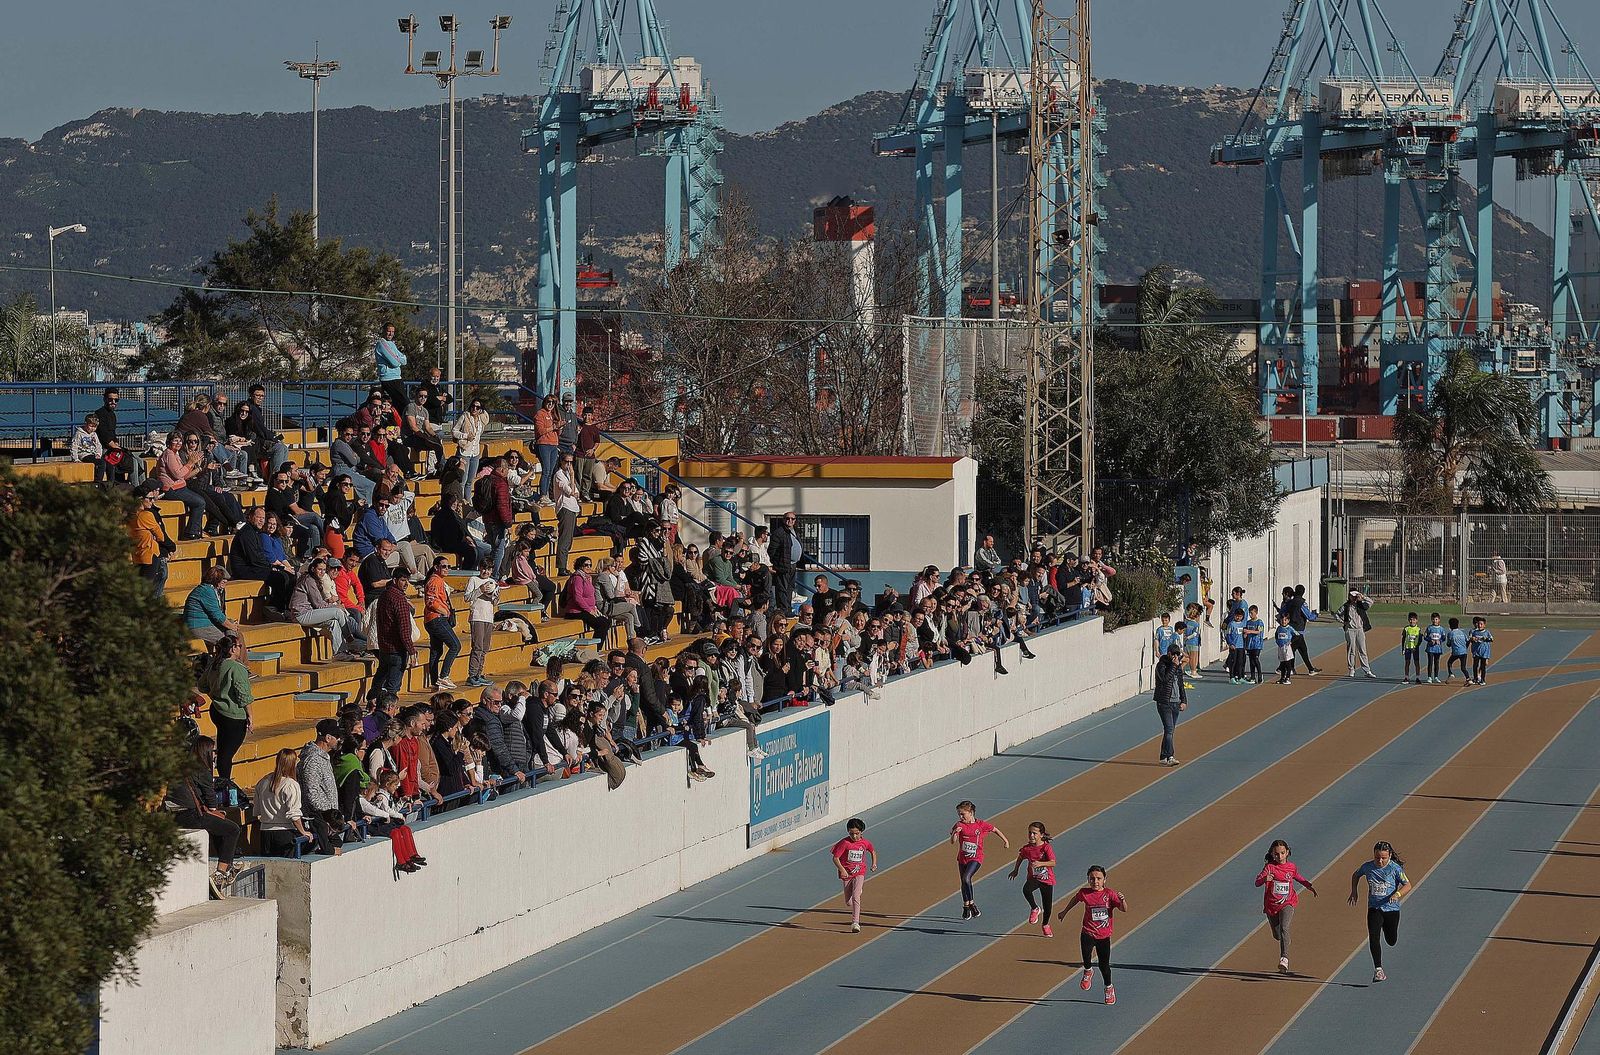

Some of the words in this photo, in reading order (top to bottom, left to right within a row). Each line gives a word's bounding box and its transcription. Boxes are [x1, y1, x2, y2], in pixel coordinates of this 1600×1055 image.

[1381, 93, 1449, 102] ERMINALS
[765, 758, 794, 799] Enrique
[795, 749, 823, 785] Talavera
